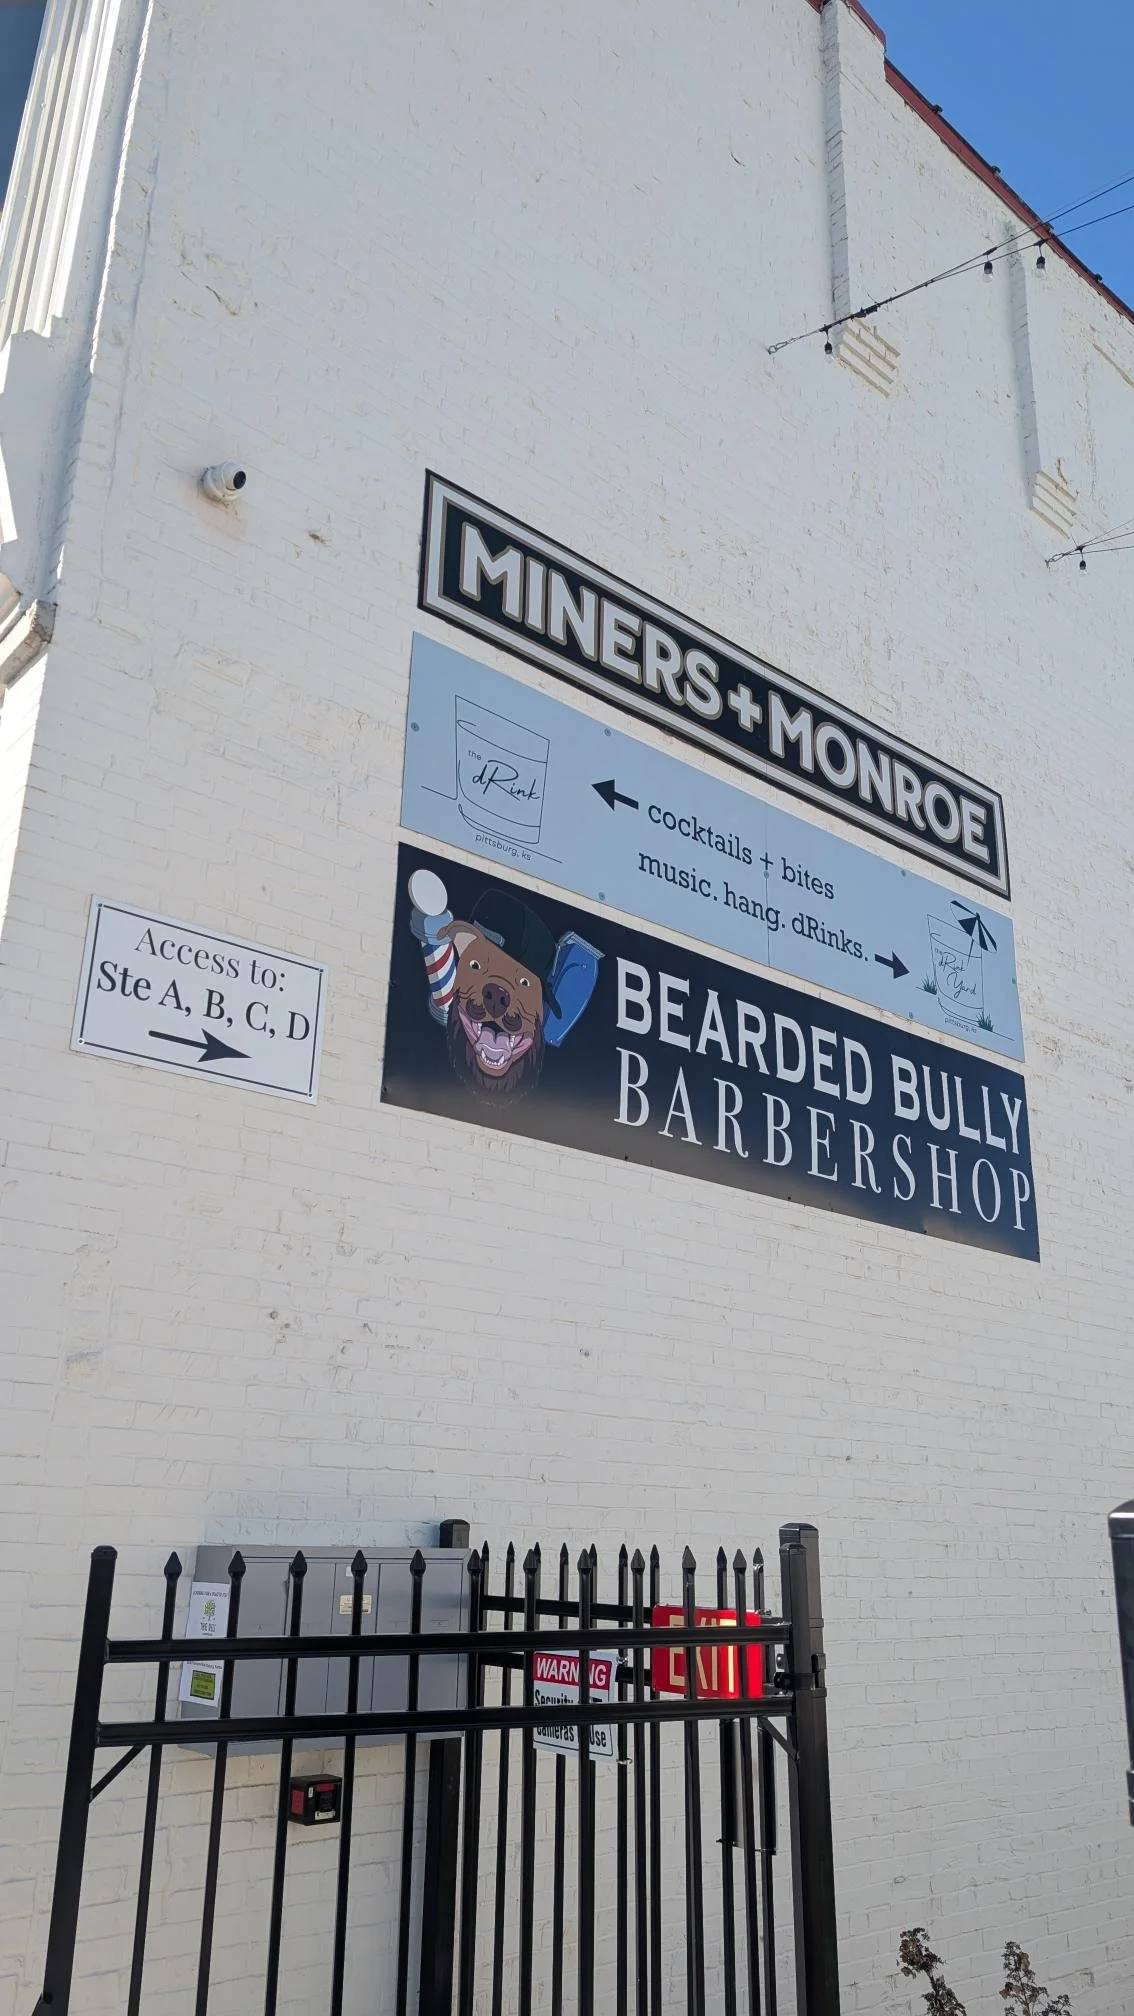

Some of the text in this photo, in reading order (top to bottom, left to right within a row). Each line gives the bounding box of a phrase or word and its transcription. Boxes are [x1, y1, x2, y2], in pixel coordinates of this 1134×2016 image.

[467, 750, 482, 760] the
[472, 760, 541, 801] dRink
[475, 834, 532, 861] pittsburg, ks
[648, 804, 752, 865] cocktails
[781, 857, 834, 900] bites
[638, 852, 868, 962] music. hang. dRinks.
[134, 928, 285, 992] Access to:
[946, 972, 977, 999] Yard
[97, 961, 310, 1041] Ste A, B, C, D
[617, 957, 1023, 1155] BEARDED BULLY
[614, 1047, 1031, 1231] BARBERSHOP
[534, 1689, 574, 1707] Securit
[537, 1657, 607, 1687] WARNNG
